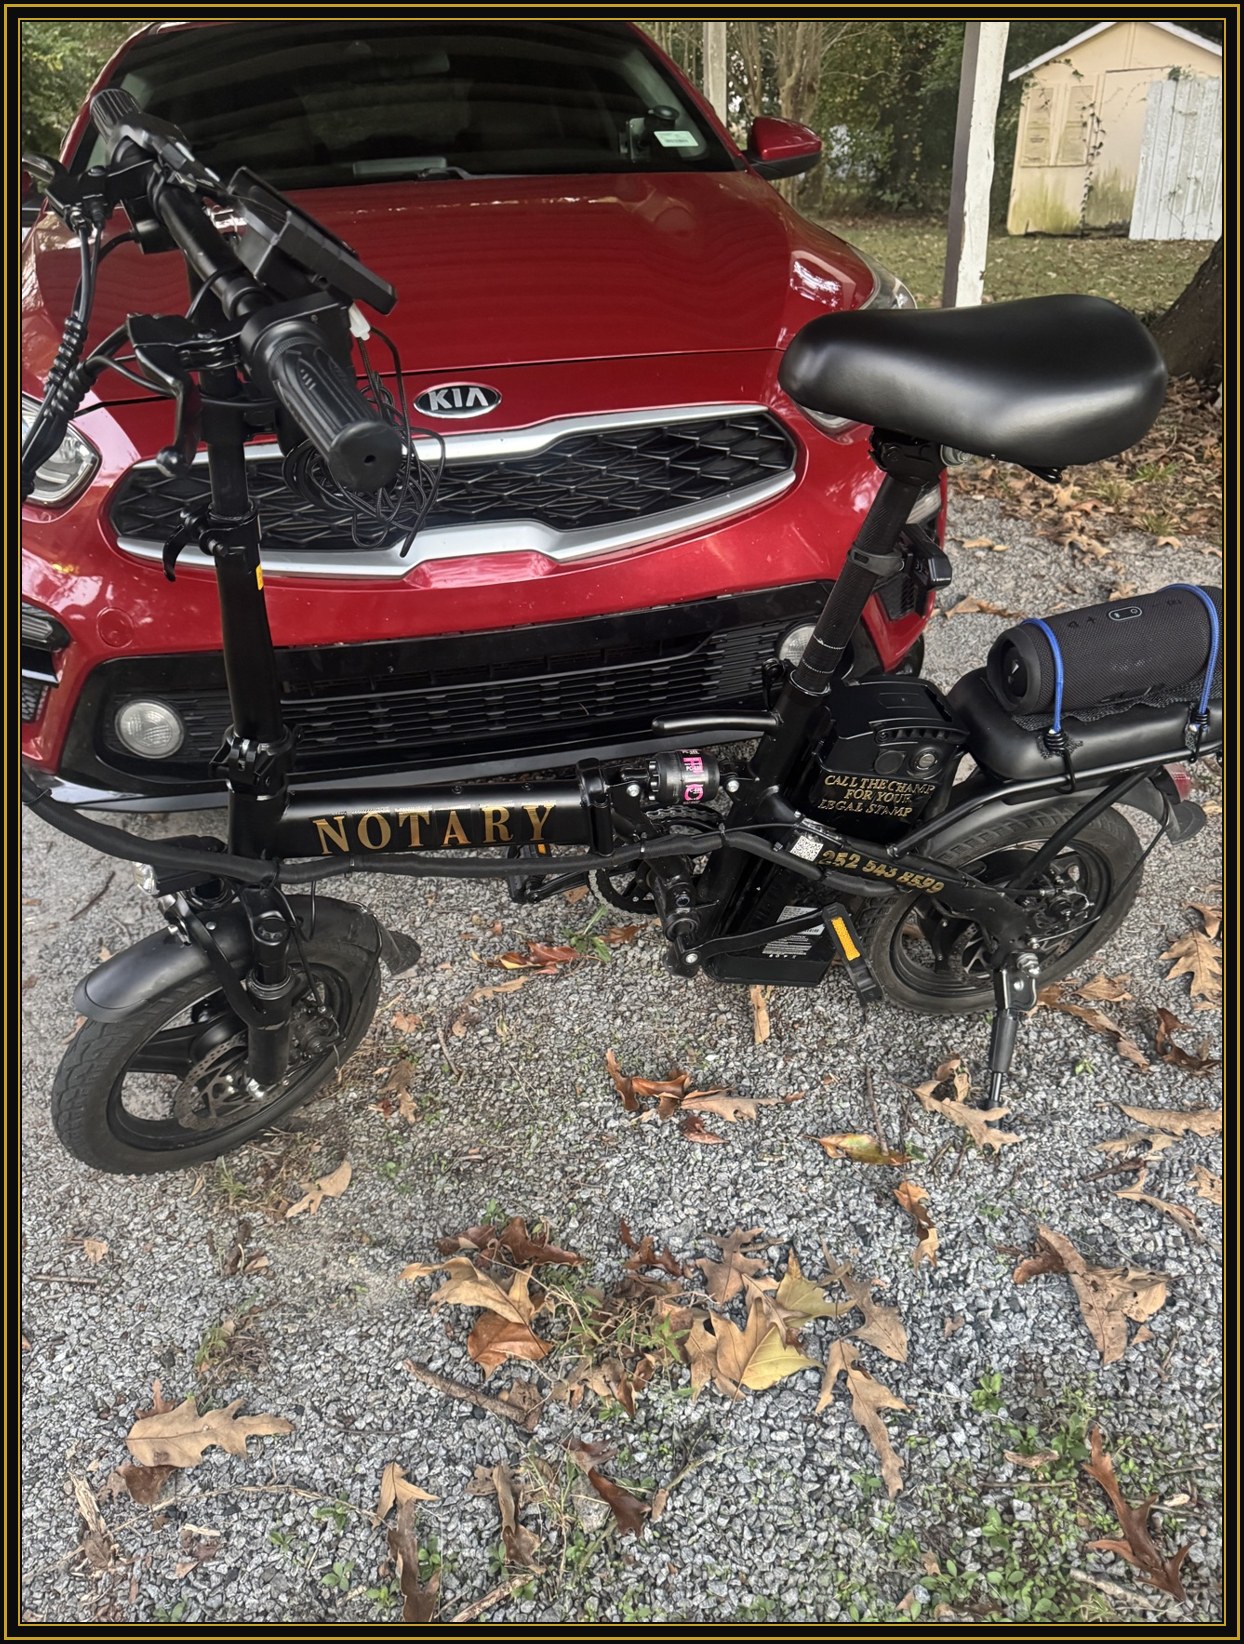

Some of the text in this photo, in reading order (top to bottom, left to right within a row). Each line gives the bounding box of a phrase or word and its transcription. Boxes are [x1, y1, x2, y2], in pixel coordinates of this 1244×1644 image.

[428, 387, 489, 411] KIA
[824, 775, 936, 794] CALL THE CHAMP
[844, 789, 912, 804] FOR YOUR
[817, 799, 913, 817] LEGAL STAMP
[312, 803, 555, 855] NOTARY
[817, 849, 861, 869] 252
[896, 871, 945, 894] 8599
